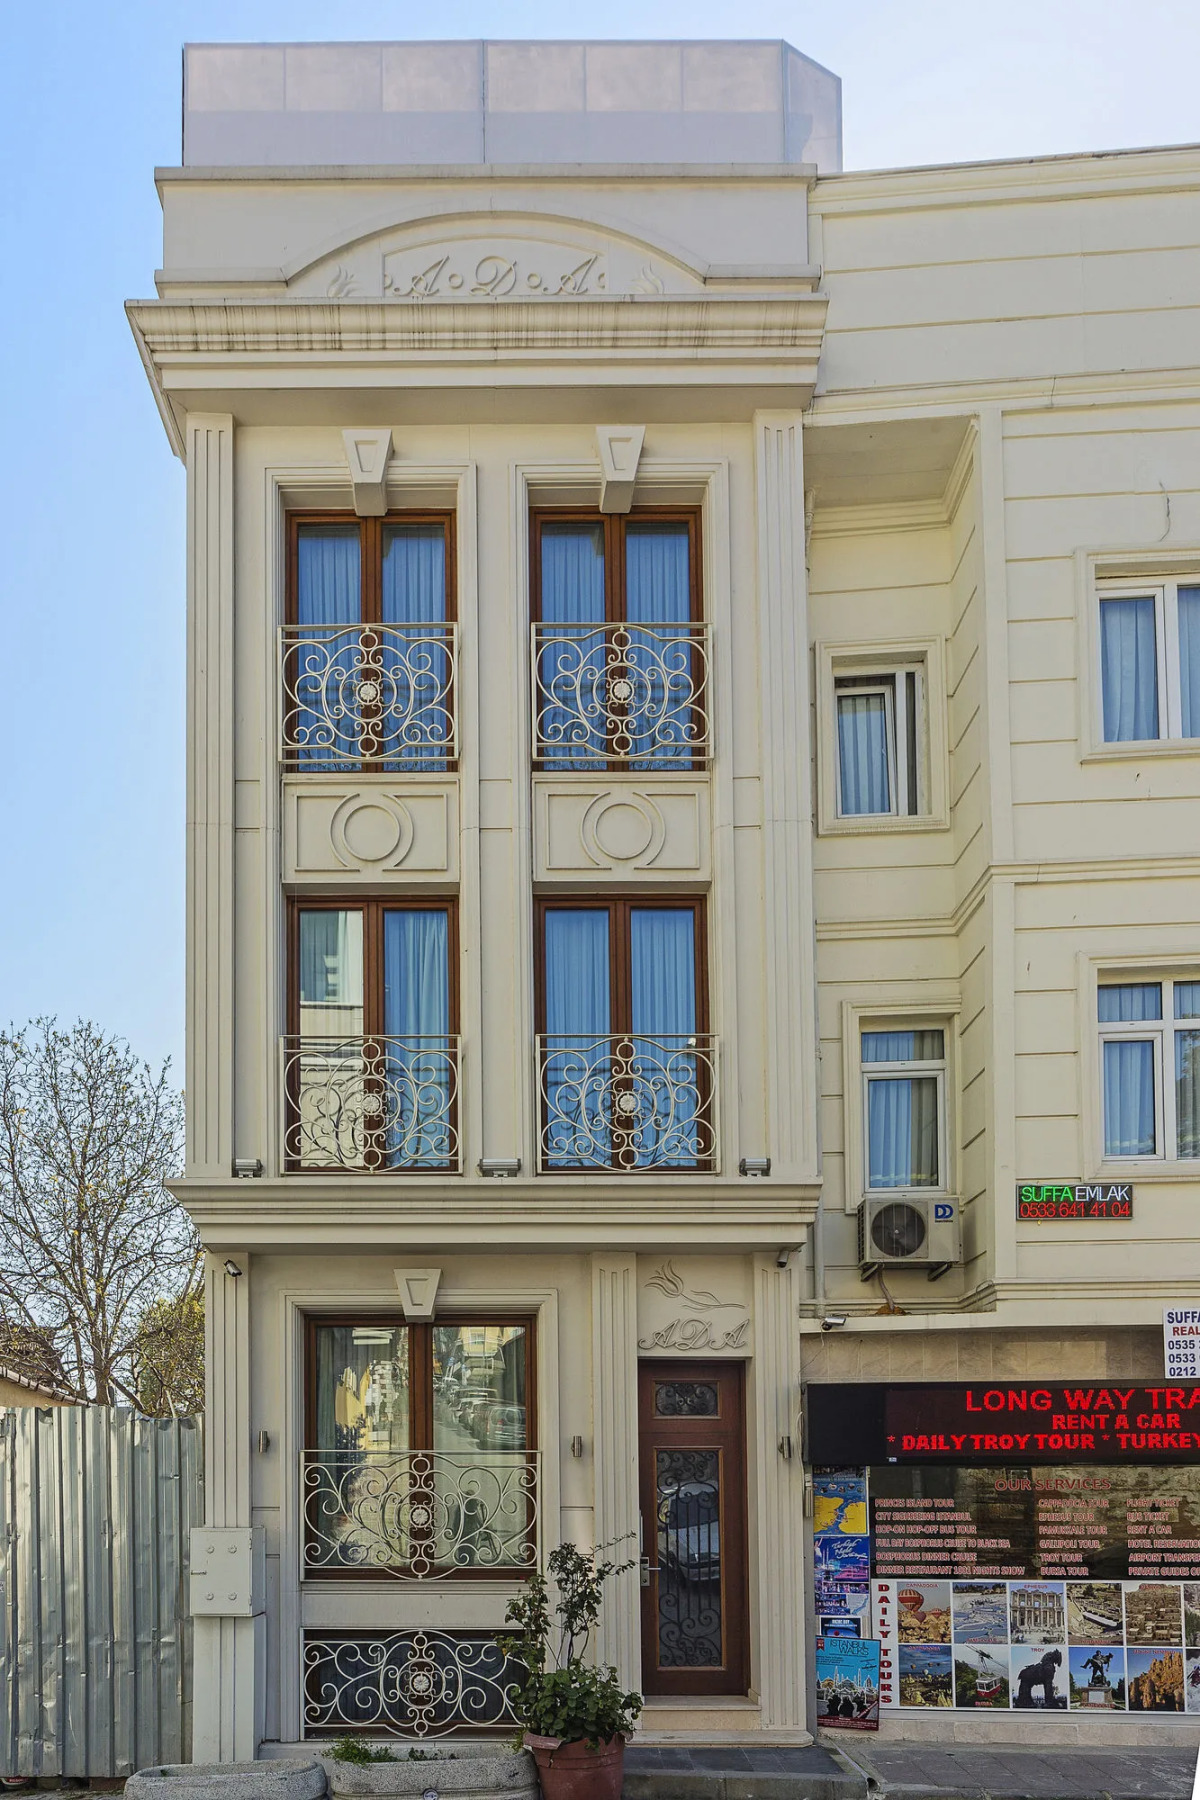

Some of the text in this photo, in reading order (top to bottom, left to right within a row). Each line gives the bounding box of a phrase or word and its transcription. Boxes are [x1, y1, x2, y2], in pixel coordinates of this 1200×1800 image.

[1021, 1186, 1130, 1201] SUFFA EMLAK
[1020, 1202, 1130, 1217] 0533 641 41 04
[1167, 1311, 1200, 1324] SUFF
[637, 1318, 750, 1351] ADA
[1168, 1340, 1195, 1350] 0535
[1168, 1353, 1196, 1363] 0533
[1169, 1366, 1196, 1377] 0212
[966, 1389, 1053, 1411] LONG
[1063, 1389, 1136, 1410] WAY
[1052, 1413, 1182, 1429] RENT A CAR
[902, 1434, 967, 1450] DAILY
[970, 1434, 1031, 1450] TROY
[1034, 1433, 1095, 1449] TOUR
[995, 1478, 1112, 1491] OUR SERVICES
[875, 1499, 955, 1508] PRINCES ISLAND TOUR
[1088, 1499, 1109, 1508] TOUR
[1154, 1499, 1180, 1508] TICKET
[875, 1511, 892, 1521] CITY
[1039, 1512, 1095, 1521] EPHESUS TOUR
[1126, 1512, 1170, 1521] BUS TICKET
[875, 1524, 978, 1534] HOP-ON HOP-OFF BUS TOUR
[1086, 1525, 1108, 1535] TOUR
[1127, 1525, 1172, 1534] RENT A CAR
[967, 1538, 977, 1548] TO
[1040, 1539, 1101, 1549] GALLIPOLI TOUR
[1127, 1539, 1200, 1549] HOTEL RESERVATIO
[875, 1552, 920, 1561] BOSPHORUS
[921, 1552, 950, 1561] DINNER
[951, 1552, 977, 1561] CRUISE
[1040, 1553, 1083, 1562] TROY TOUR
[1128, 1553, 1163, 1562] AIRPORT
[875, 1565, 905, 1574] DINNER
[905, 1565, 952, 1574] RESTAURANT
[1000, 1565, 1026, 1574] SHOW
[1040, 1566, 1089, 1576] BURSA TOUR
[1128, 1567, 1160, 1576] PRIVATE
[1160, 1567, 1190, 1576] GUIDES
[878, 1584, 893, 1704] DAILY TOURS
